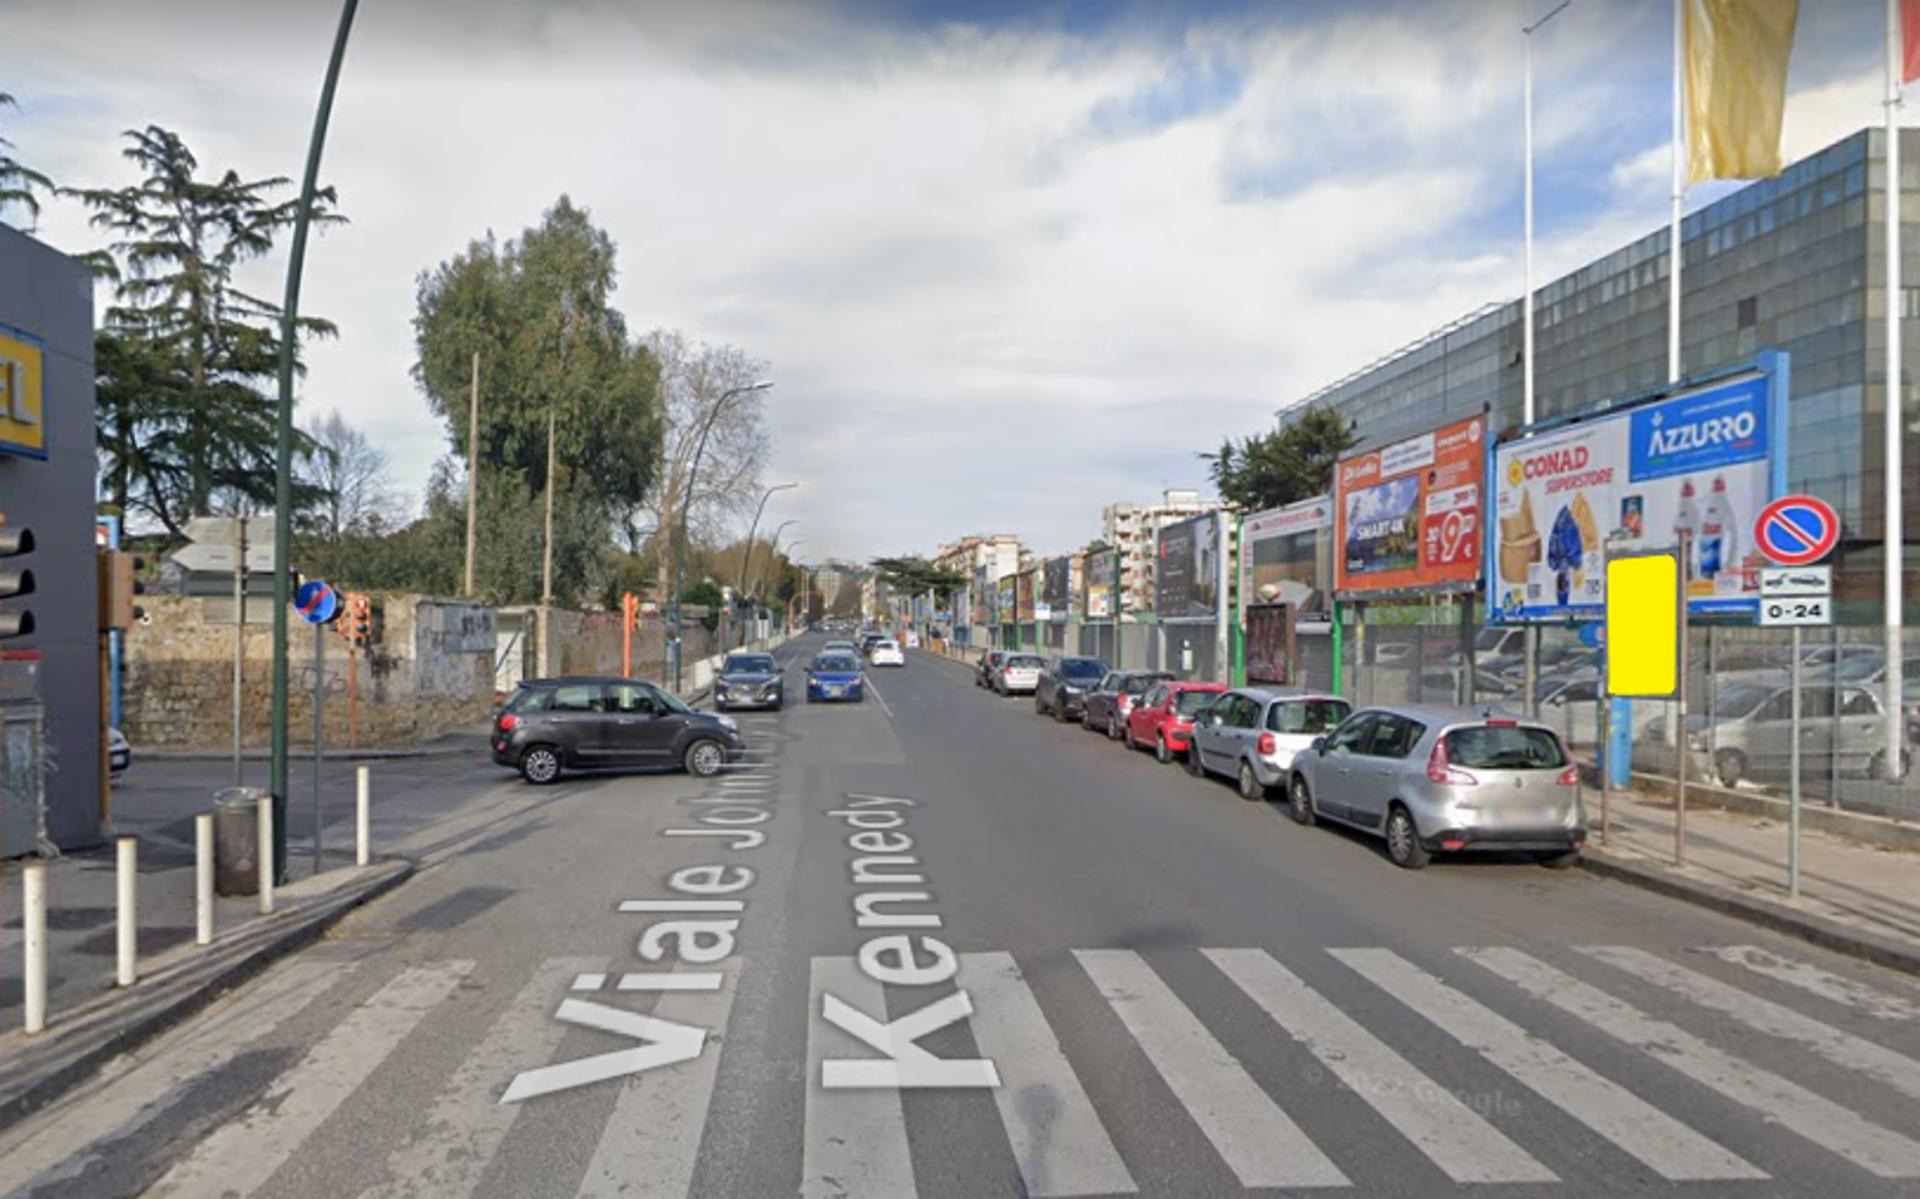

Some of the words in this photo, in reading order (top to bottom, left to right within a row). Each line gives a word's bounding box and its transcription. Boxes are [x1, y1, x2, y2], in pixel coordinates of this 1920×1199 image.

[1524, 446, 1588, 480] CONAD
[1545, 467, 1614, 494] SUPERSTORE
[1357, 520, 1390, 541] SMART
